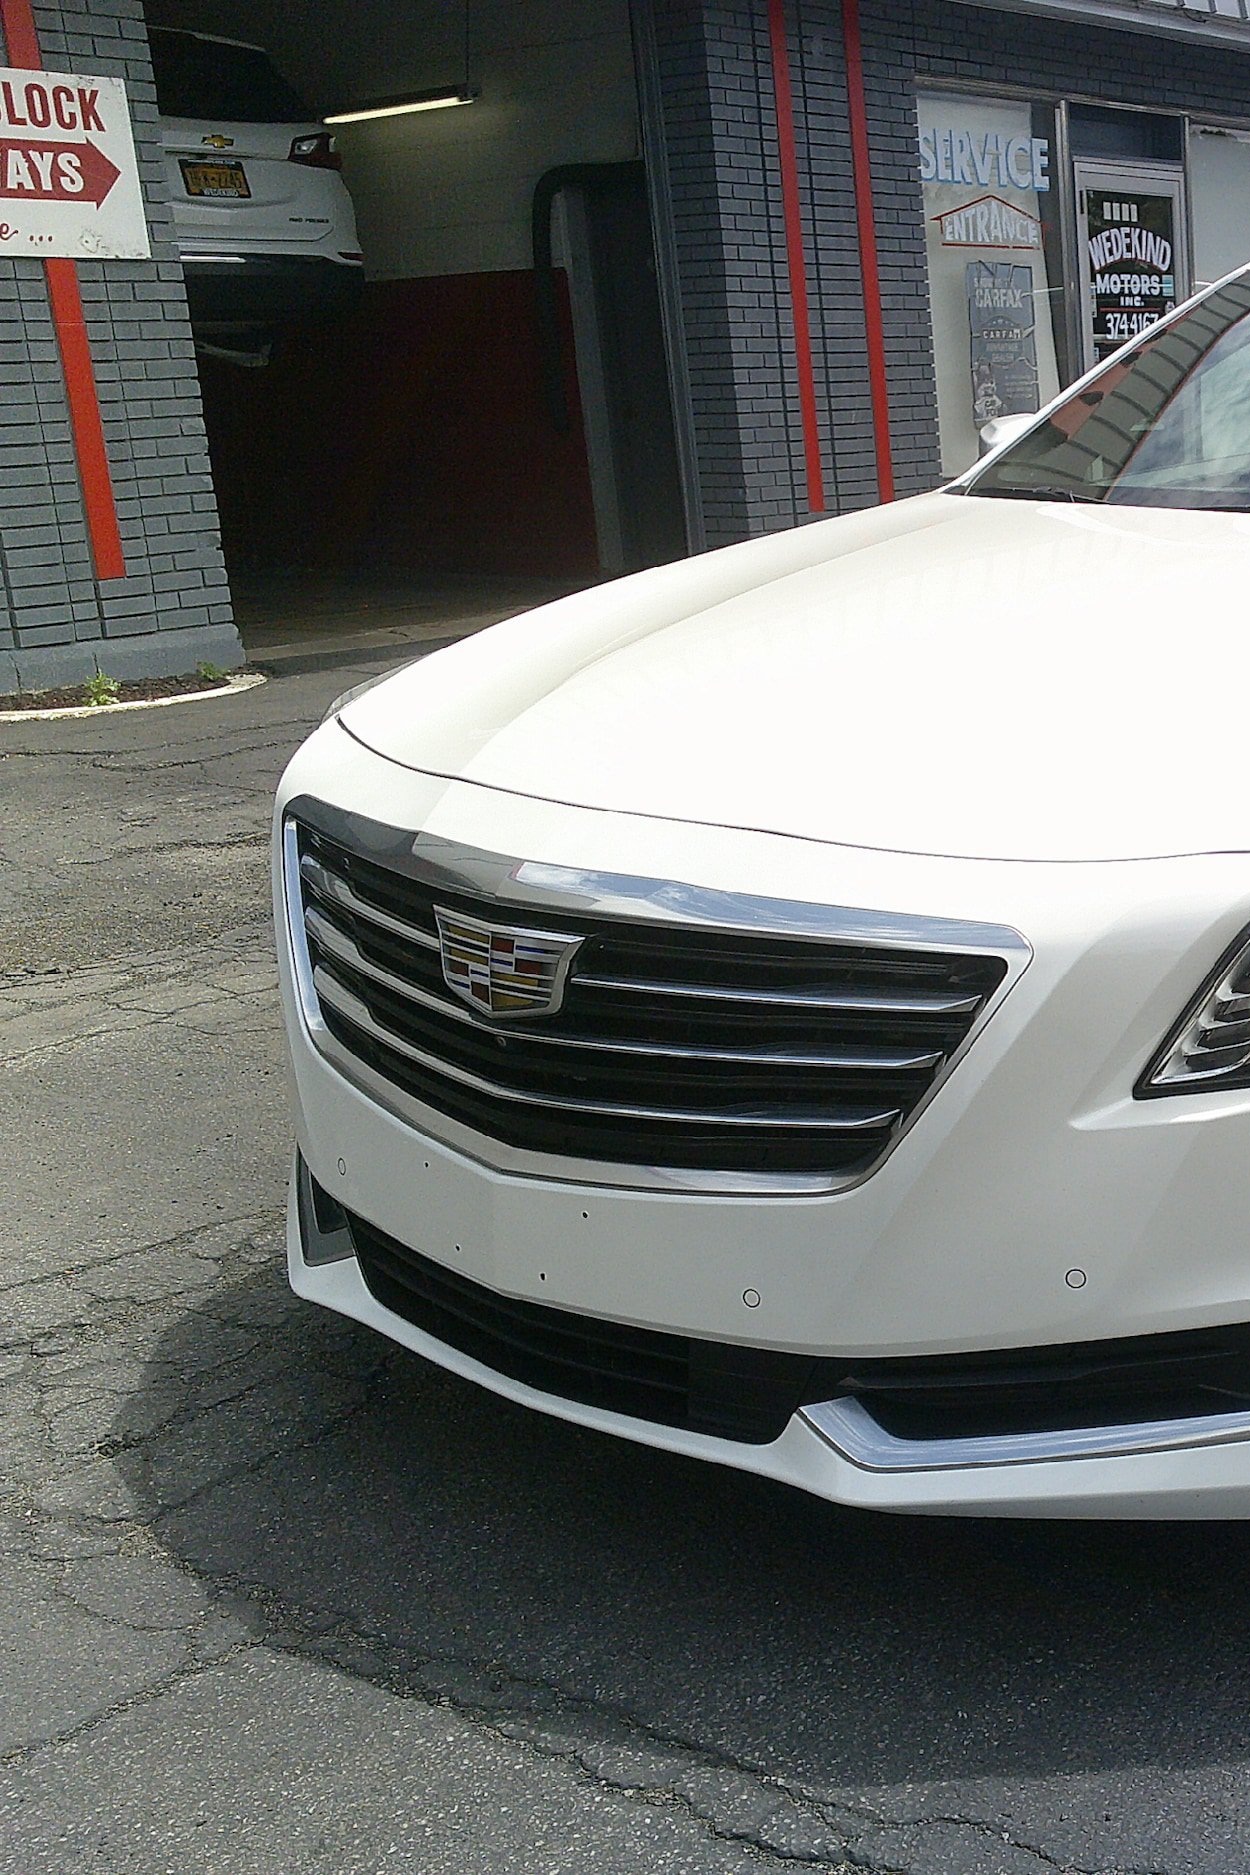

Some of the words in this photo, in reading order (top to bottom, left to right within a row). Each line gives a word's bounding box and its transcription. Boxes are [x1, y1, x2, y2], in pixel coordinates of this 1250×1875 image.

[0, 81, 106, 132] LOCK
[0, 149, 84, 193] AYS
[919, 128, 1050, 192] SERVICE
[945, 201, 1038, 244] ENTRANCE
[1088, 227, 1172, 271] WEDEKIND
[975, 288, 1023, 308] CARFAX
[1096, 273, 1161, 295] MOTORS
[1119, 296, 1145, 307] INC.
